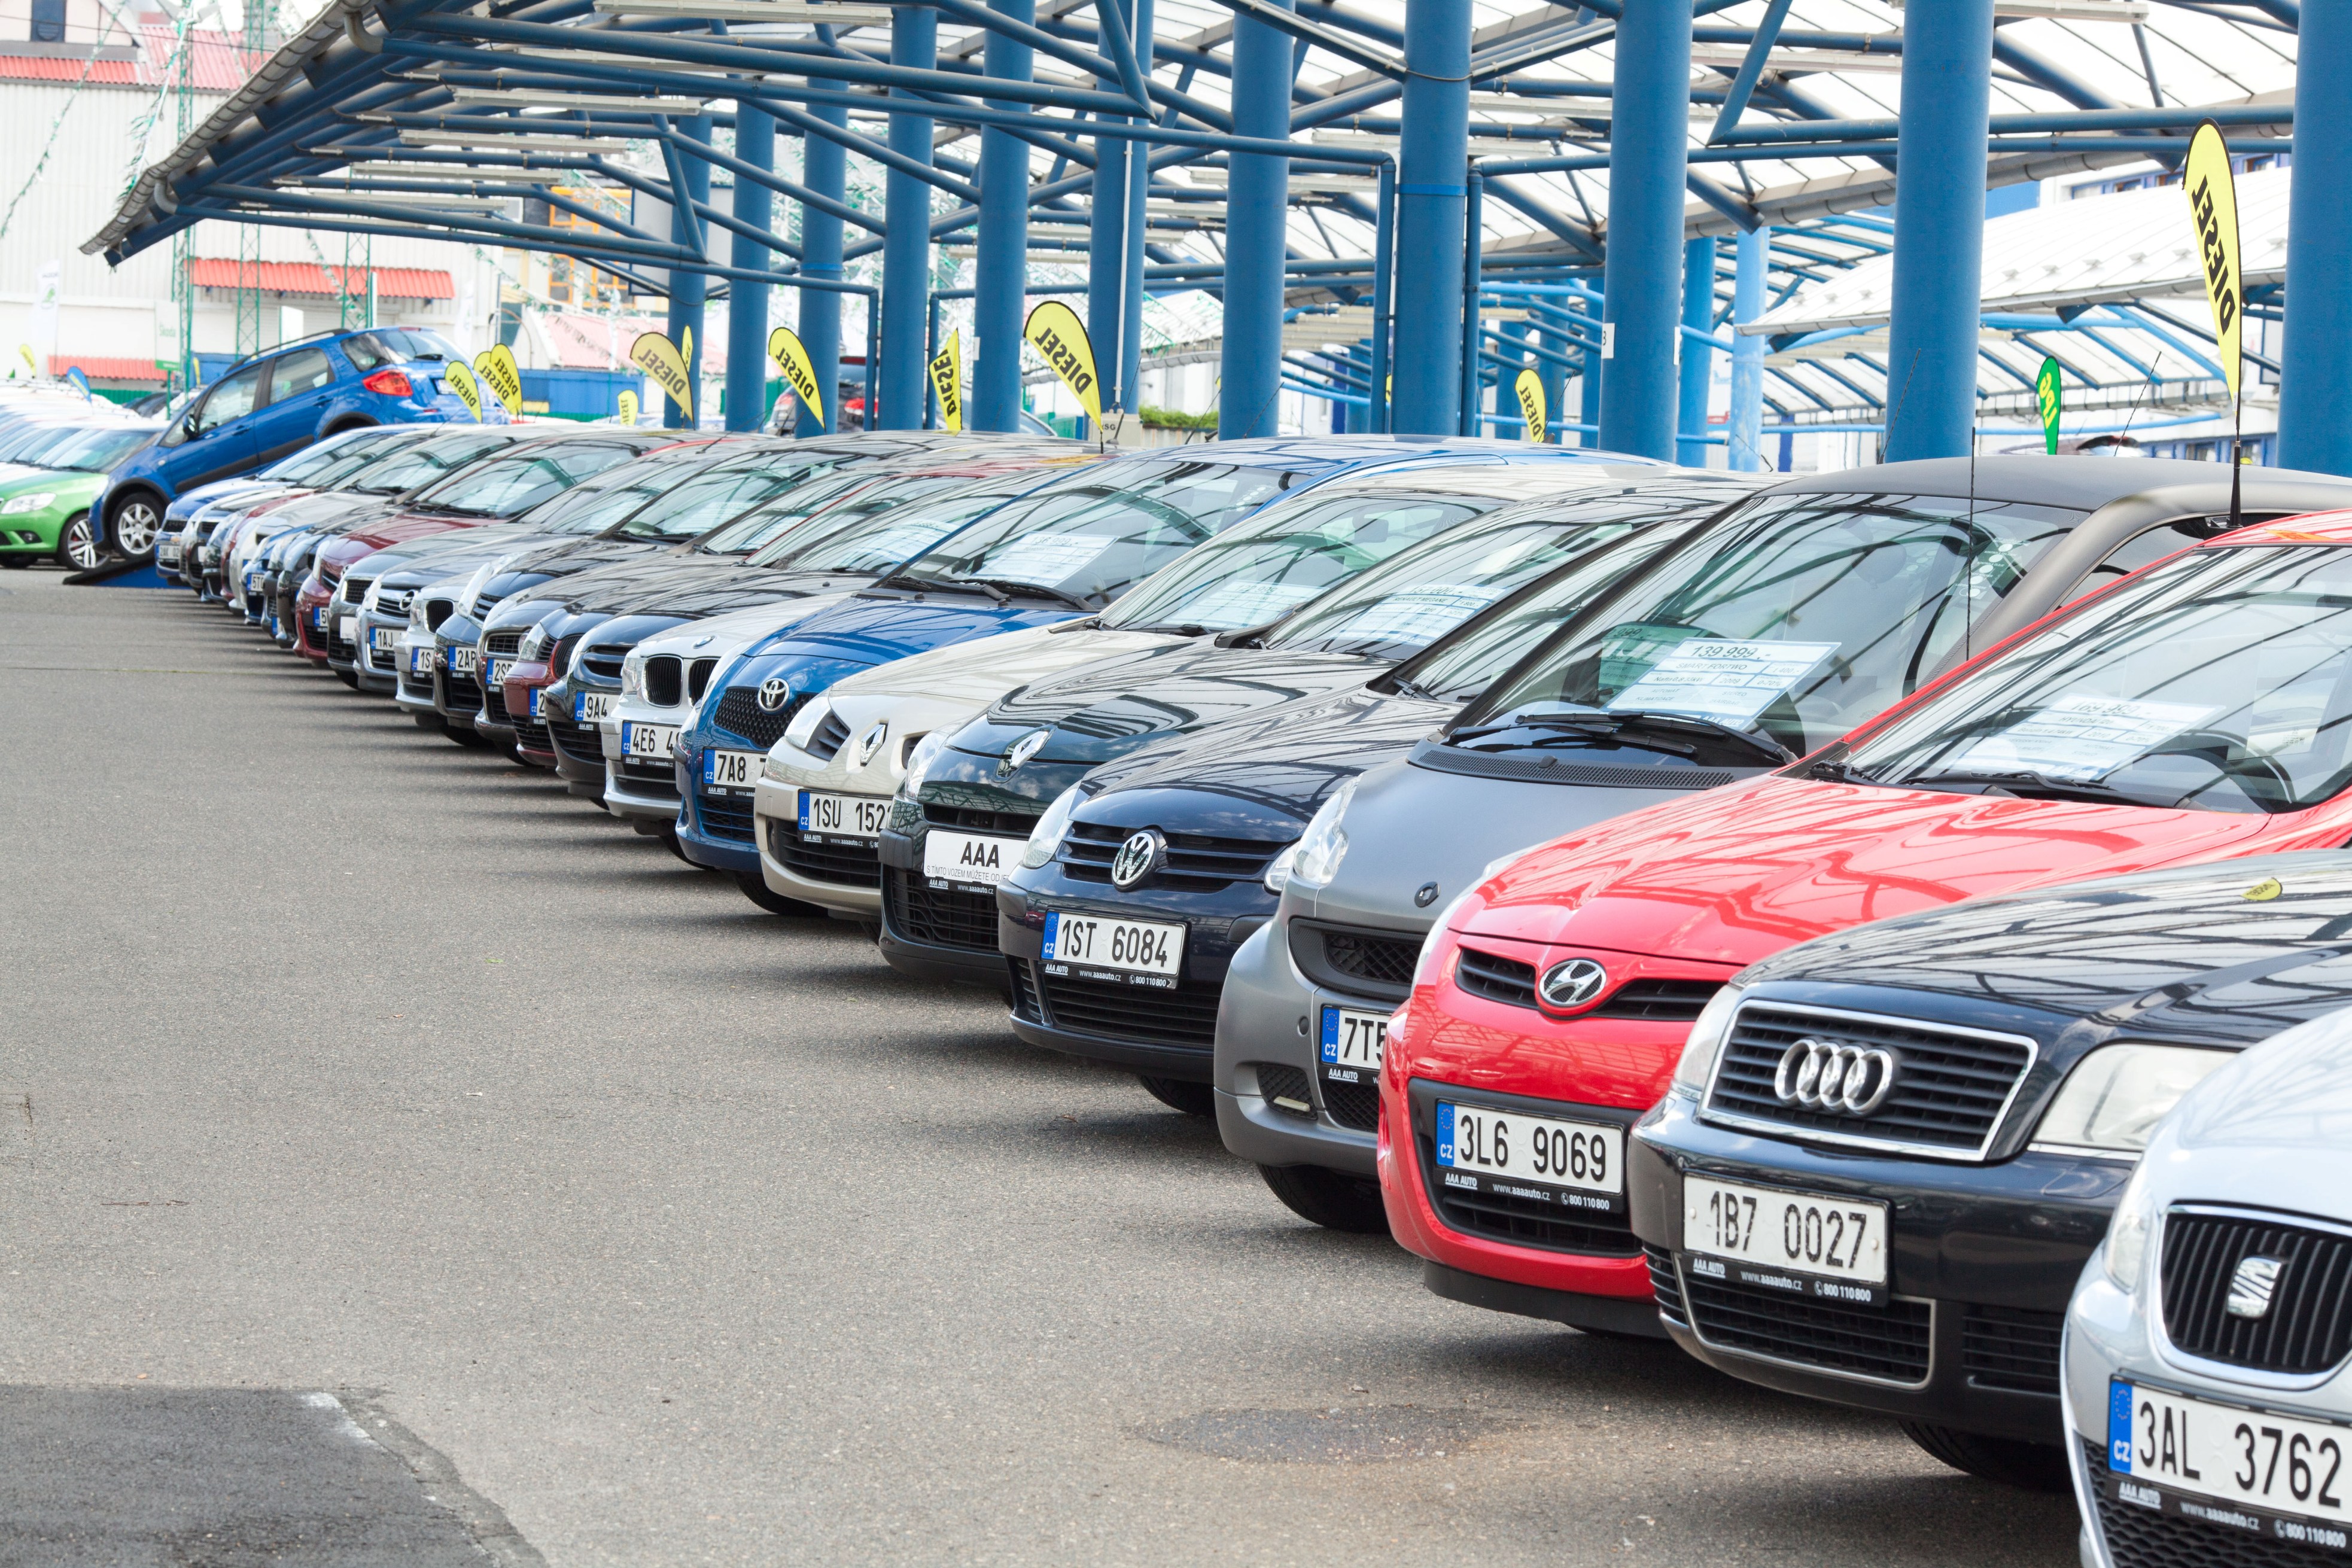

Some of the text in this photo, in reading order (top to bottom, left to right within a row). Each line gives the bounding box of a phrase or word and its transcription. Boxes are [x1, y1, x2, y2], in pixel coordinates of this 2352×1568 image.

[378, 631, 394, 647] 1AJ
[1691, 646, 1721, 657] 139
[421, 651, 433, 669] 1S
[586, 696, 607, 719] 9A4
[633, 727, 656, 752] 4E6
[718, 754, 746, 782] 7A8
[801, 798, 891, 833] CZ 1SU 152
[830, 838, 863, 847] www.aaaauto.cz
[960, 841, 1000, 868] AAA
[948, 868, 965, 878] VOZEM
[957, 885, 994, 894] www.aaaauto.cz
[1045, 920, 1168, 967] CZ 1ST 6084
[1045, 964, 1055, 972] AAA
[1056, 965, 1069, 973] AUTO
[1079, 970, 1121, 981] www.aaaauto.cz
[1325, 1043, 1336, 1057] CZ
[1328, 1068, 1358, 1080] AAA AUTO
[1440, 1115, 1606, 1182] CZ 3L6 9069
[1446, 1173, 1459, 1183] AAA
[1461, 1176, 1477, 1187] AUTO
[1493, 1183, 1550, 1201] www.aaaauto.cz
[1569, 1195, 1582, 1205] 800
[1711, 1191, 1867, 1268] 1B7 0027
[1693, 1258, 1708, 1271] AAA
[1708, 1262, 1725, 1275] AUTO
[1741, 1271, 1802, 1290] www.aaaauto.cz
[1824, 1283, 1838, 1296] 800
[2114, 1402, 2341, 1509] CZ 3AL 3762
[2119, 1482, 2137, 1500] AAA
[2138, 1487, 2161, 1505] AUTO
[2180, 1502, 2260, 1530] www.aaaauto.cz
